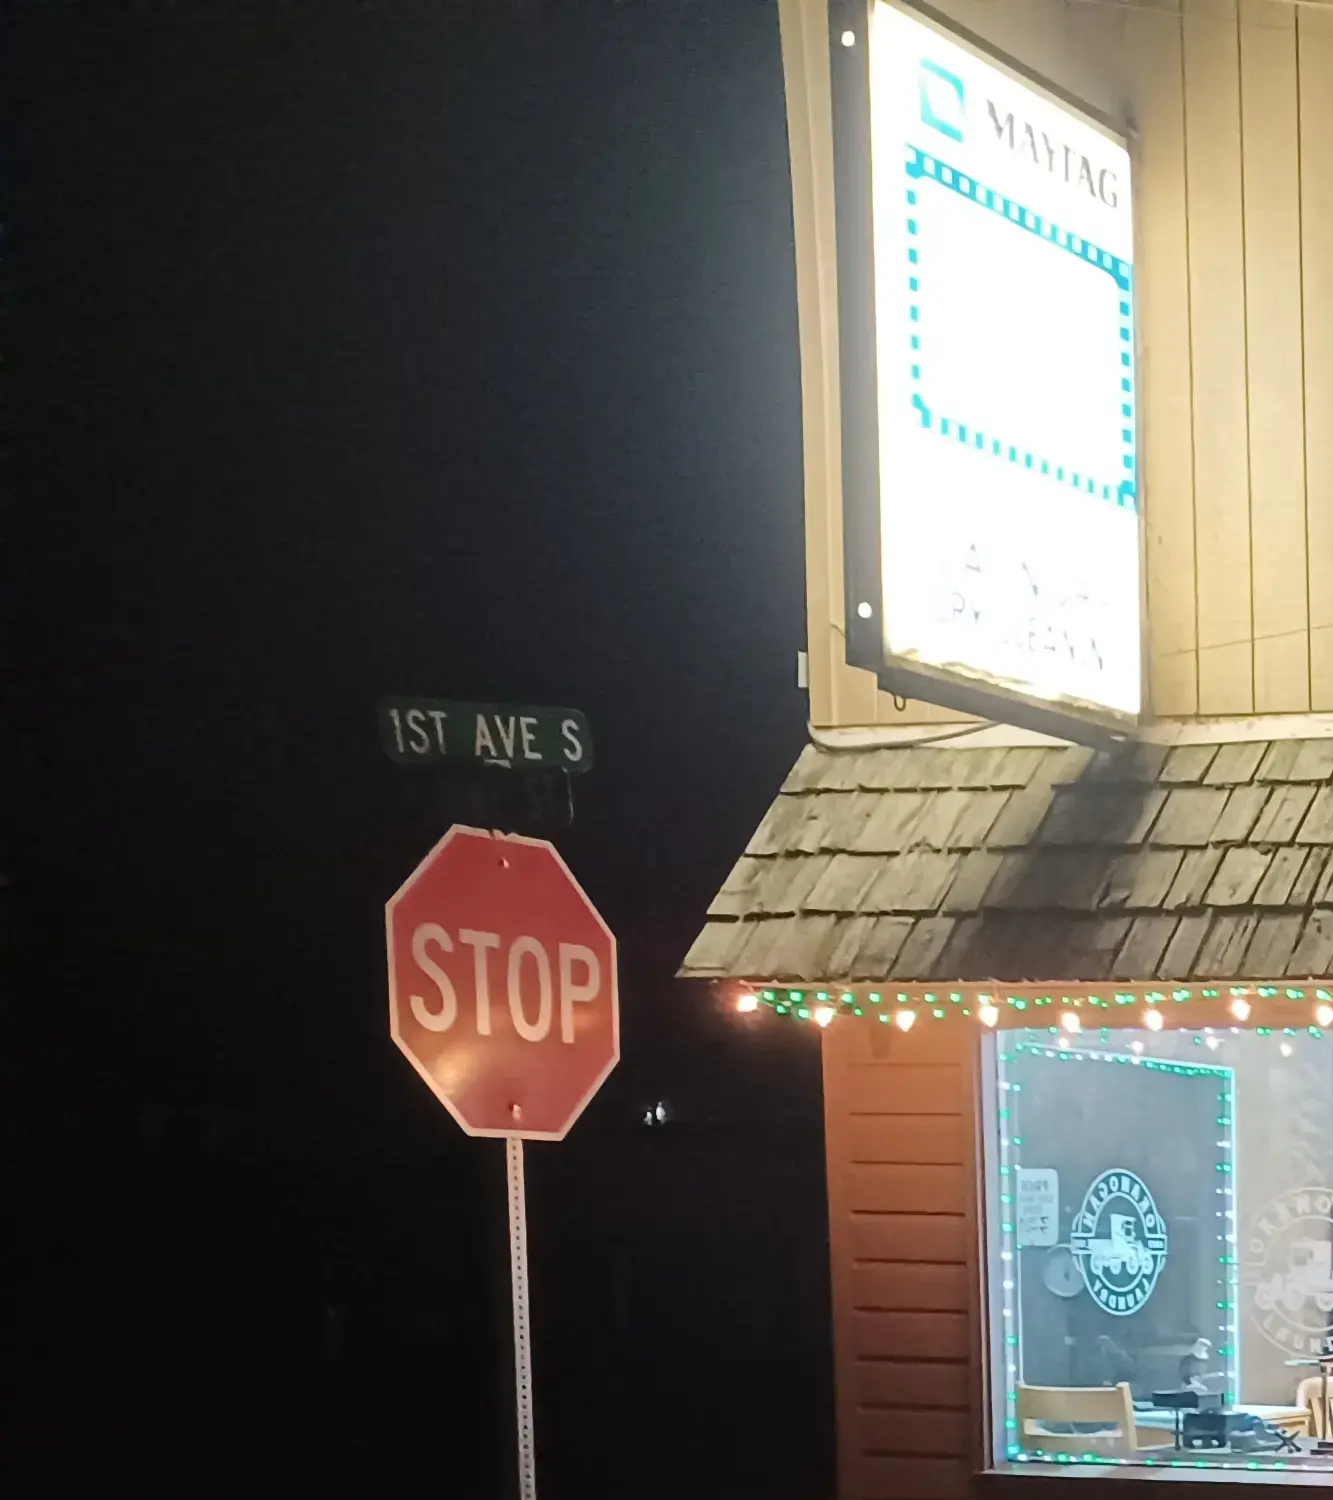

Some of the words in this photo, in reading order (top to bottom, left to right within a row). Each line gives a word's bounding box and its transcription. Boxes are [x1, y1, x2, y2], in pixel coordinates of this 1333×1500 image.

[985, 97, 1120, 210] MAYTAG
[388, 707, 449, 754] 1ST
[474, 713, 543, 761] AVE
[560, 719, 584, 762] S
[409, 922, 601, 1045] STOP
